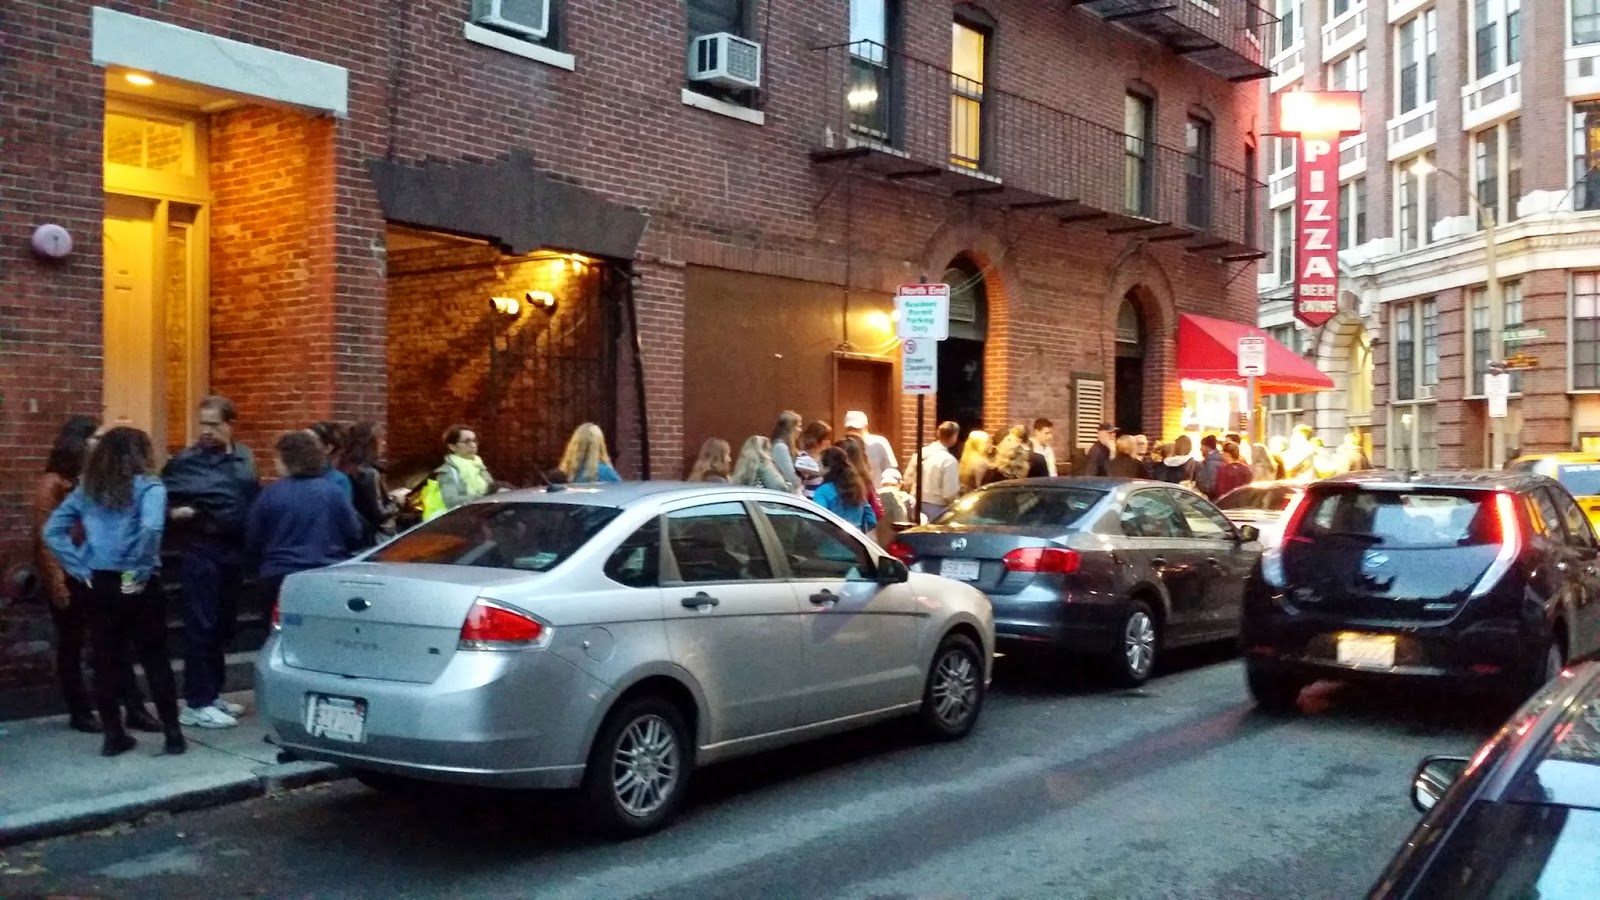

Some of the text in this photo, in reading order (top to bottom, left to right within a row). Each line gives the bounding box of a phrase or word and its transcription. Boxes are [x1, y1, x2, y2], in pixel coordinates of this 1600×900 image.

[1303, 140, 1335, 278] PIZZA
[901, 286, 927, 295] North
[1300, 284, 1335, 296] BEER
